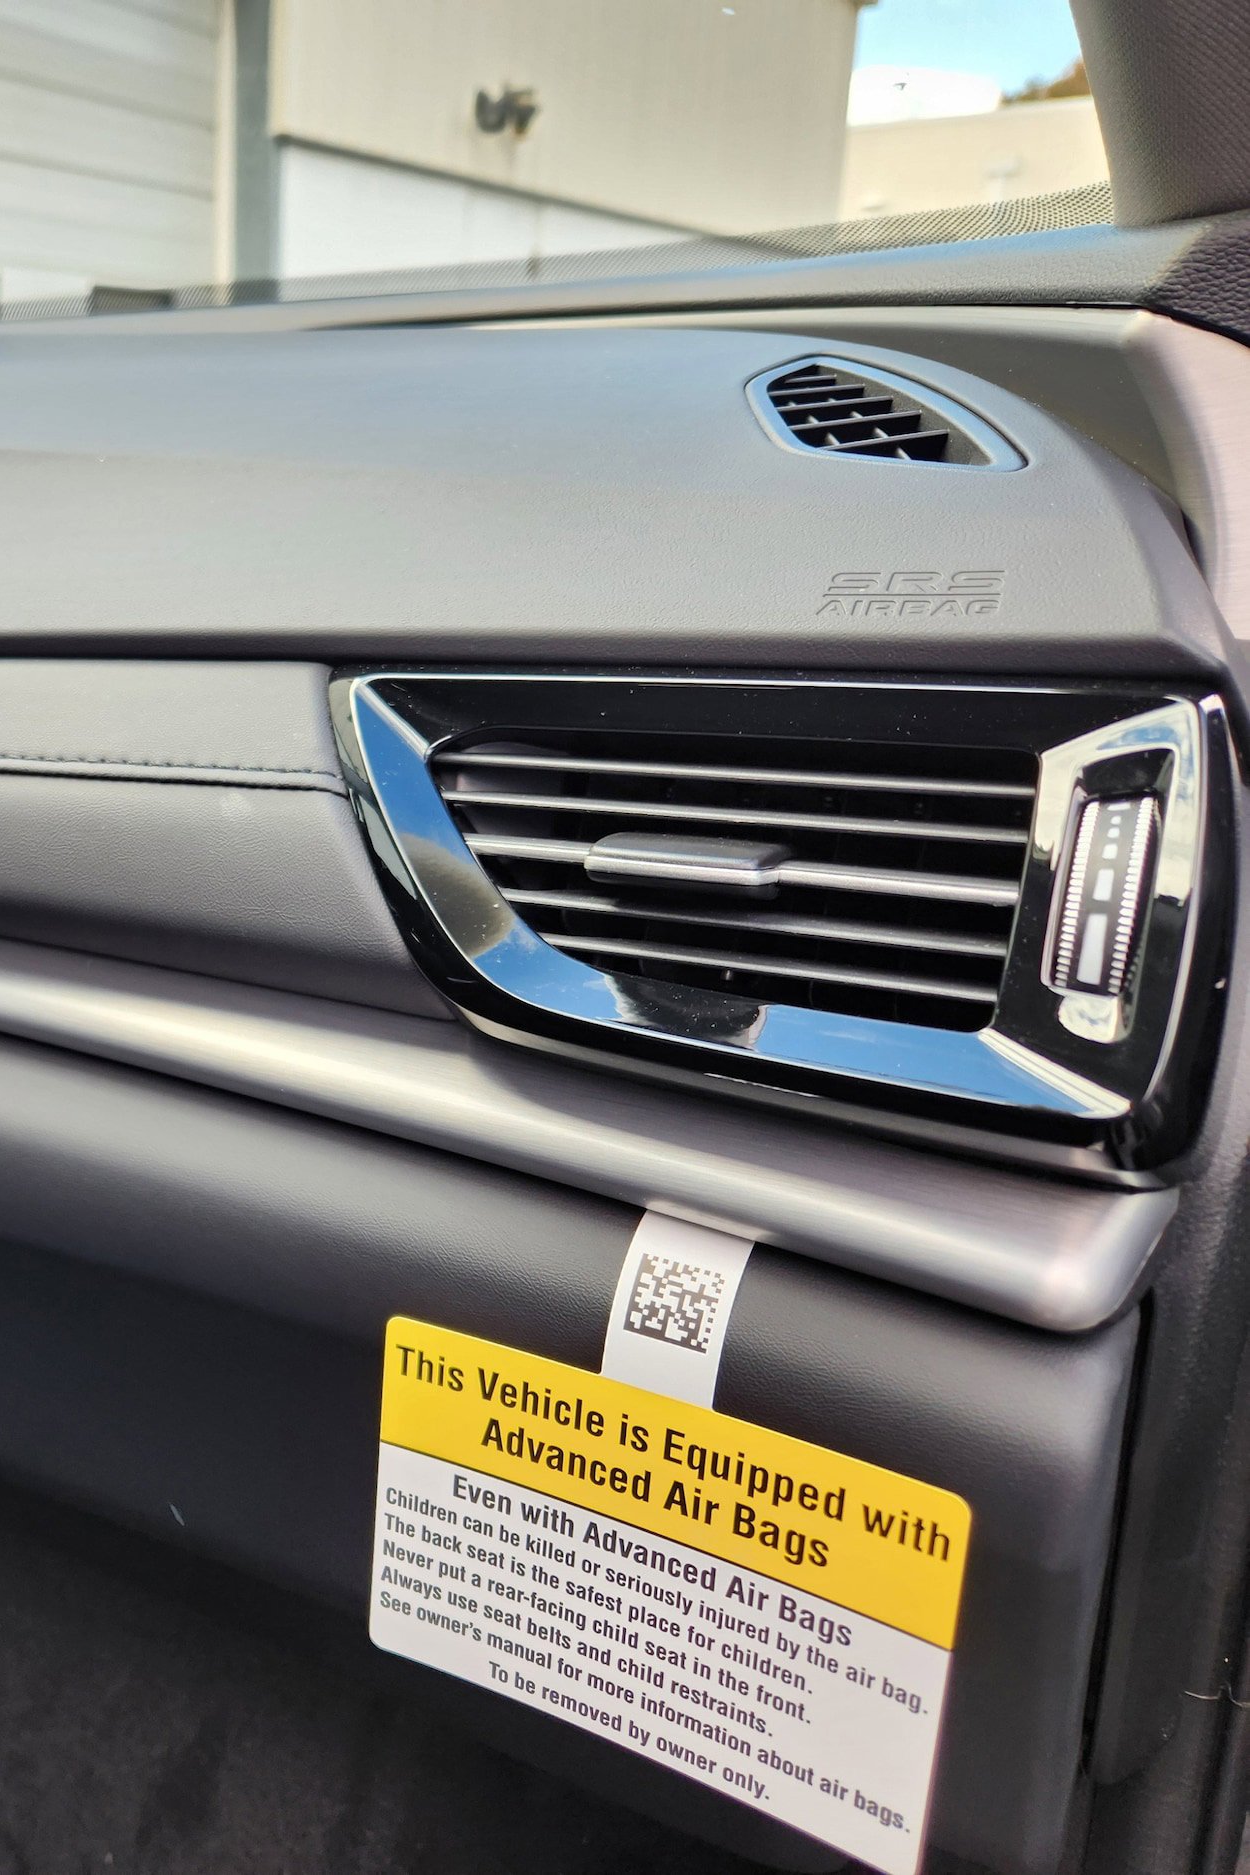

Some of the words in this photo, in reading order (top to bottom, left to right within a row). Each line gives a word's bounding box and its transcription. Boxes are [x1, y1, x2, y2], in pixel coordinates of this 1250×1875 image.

[814, 599, 1001, 617] AIRBAG
[827, 569, 1006, 592] SRS
[396, 1344, 465, 1392] This
[477, 1366, 605, 1438] Vehicle
[618, 1412, 650, 1453] is
[662, 1427, 847, 1522] Equipped
[862, 1504, 950, 1562] with
[480, 1417, 652, 1504] Advanced
[662, 1479, 720, 1526] Air
[731, 1501, 830, 1568] Bags
[383, 1538, 435, 1571] Never
[438, 1560, 467, 1583] put
[470, 1572, 482, 1589] a
[487, 1578, 587, 1632] rear-facing
[592, 1618, 640, 1650] child
[643, 1640, 688, 1671] seat
[692, 1656, 712, 1681] in
[717, 1667, 750, 1697] the
[756, 1684, 811, 1725] front.
[384, 1512, 416, 1538] The
[421, 1524, 463, 1555] back
[466, 1543, 506, 1570] seat
[510, 1555, 527, 1578] is
[530, 1564, 560, 1590] the
[564, 1580, 623, 1615] safest
[627, 1604, 681, 1638] place
[687, 1625, 716, 1652] for
[720, 1643, 813, 1695] children.
[385, 1487, 458, 1526] Children
[462, 1515, 494, 1538] can
[498, 1523, 521, 1548] be
[525, 1533, 577, 1569] killed
[581, 1558, 602, 1577] or
[604, 1567, 694, 1617] seriously
[698, 1599, 770, 1646] injured
[775, 1631, 801, 1661] by
[806, 1644, 839, 1674] the
[845, 1665, 876, 1689] air
[881, 1677, 929, 1716] bag.
[452, 1473, 512, 1516] Even
[520, 1501, 575, 1539] with
[581, 1520, 717, 1593] Advanced
[724, 1574, 770, 1612] Air
[778, 1593, 853, 1647] Bags
[379, 1590, 412, 1616] See
[416, 1606, 483, 1642] owner's
[486, 1632, 553, 1670] manual
[556, 1657, 583, 1682] for
[586, 1672, 635, 1705] more
[640, 1691, 752, 1757] information
[756, 1748, 815, 1787] about
[819, 1777, 849, 1801] air
[853, 1789, 911, 1835] bags.
[380, 1565, 442, 1601] Always
[447, 1590, 478, 1614] use
[482, 1604, 522, 1631] seat
[526, 1616, 572, 1650] belts
[576, 1640, 612, 1667] and
[616, 1657, 665, 1690] child
[670, 1679, 773, 1738] restraints.
[488, 1660, 509, 1684] To
[514, 1671, 536, 1695] be
[541, 1685, 623, 1733] removed
[628, 1719, 652, 1748] by
[656, 1736, 718, 1774] owner
[722, 1766, 770, 1800] only.
